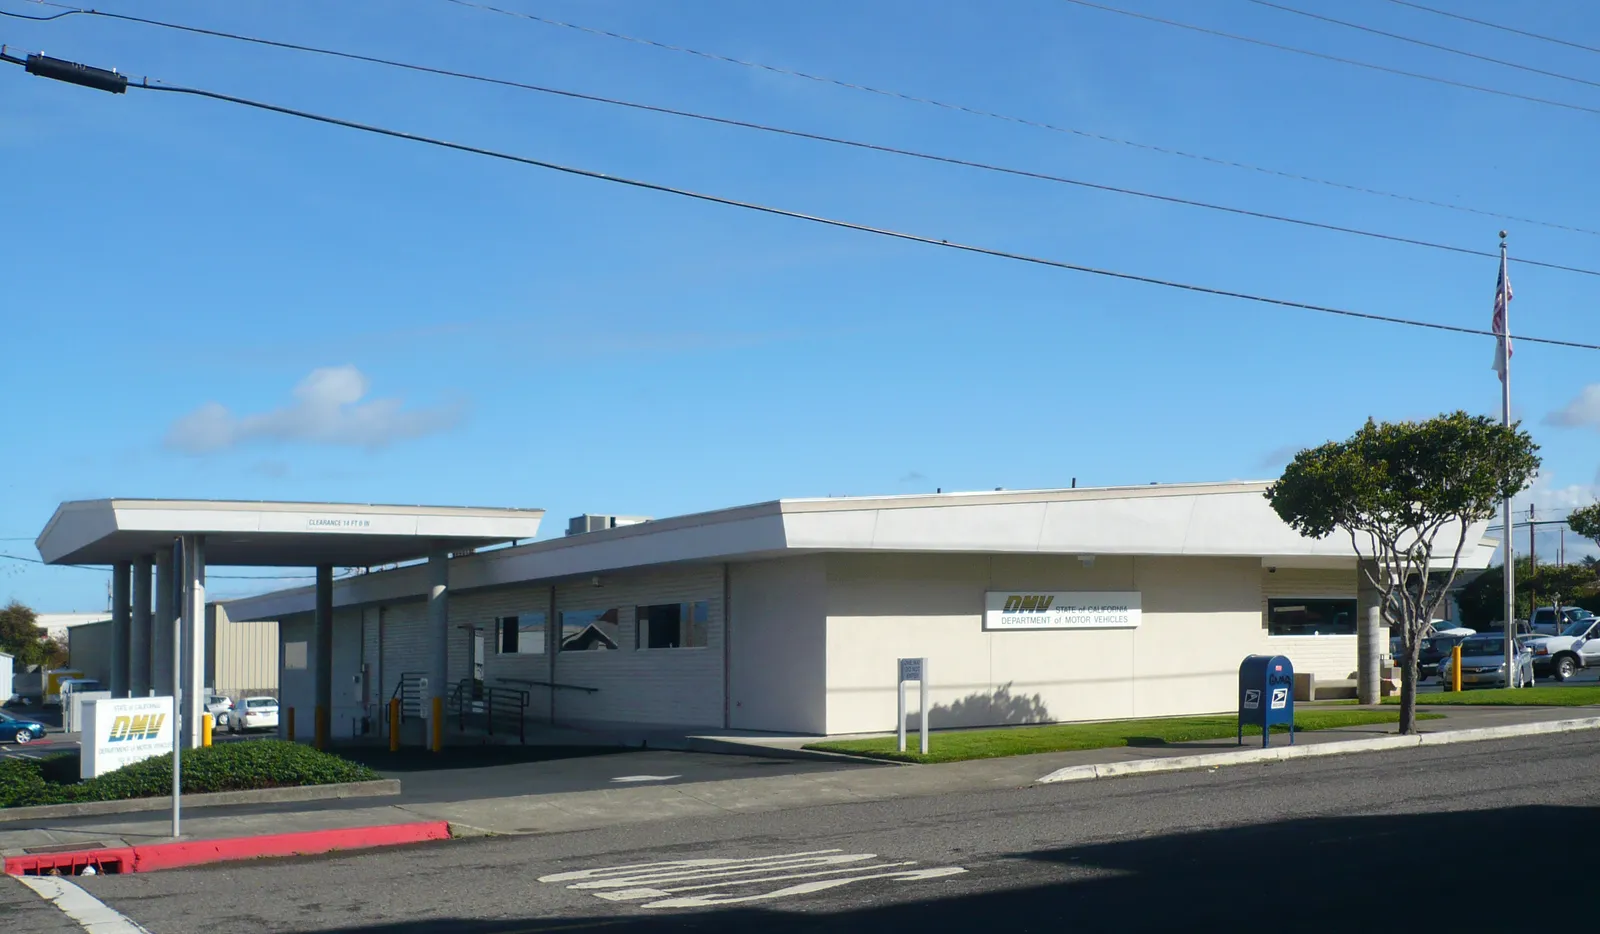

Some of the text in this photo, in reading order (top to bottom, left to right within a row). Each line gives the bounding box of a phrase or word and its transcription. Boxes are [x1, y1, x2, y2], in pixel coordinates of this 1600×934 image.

[309, 519, 341, 527] CLEARANCE
[1002, 595, 1128, 614] DMV STATE of CALIFORNIA
[1001, 615, 1128, 625] DEPARTMENT of MOTOR VEHICLES
[108, 713, 166, 742] DMV
